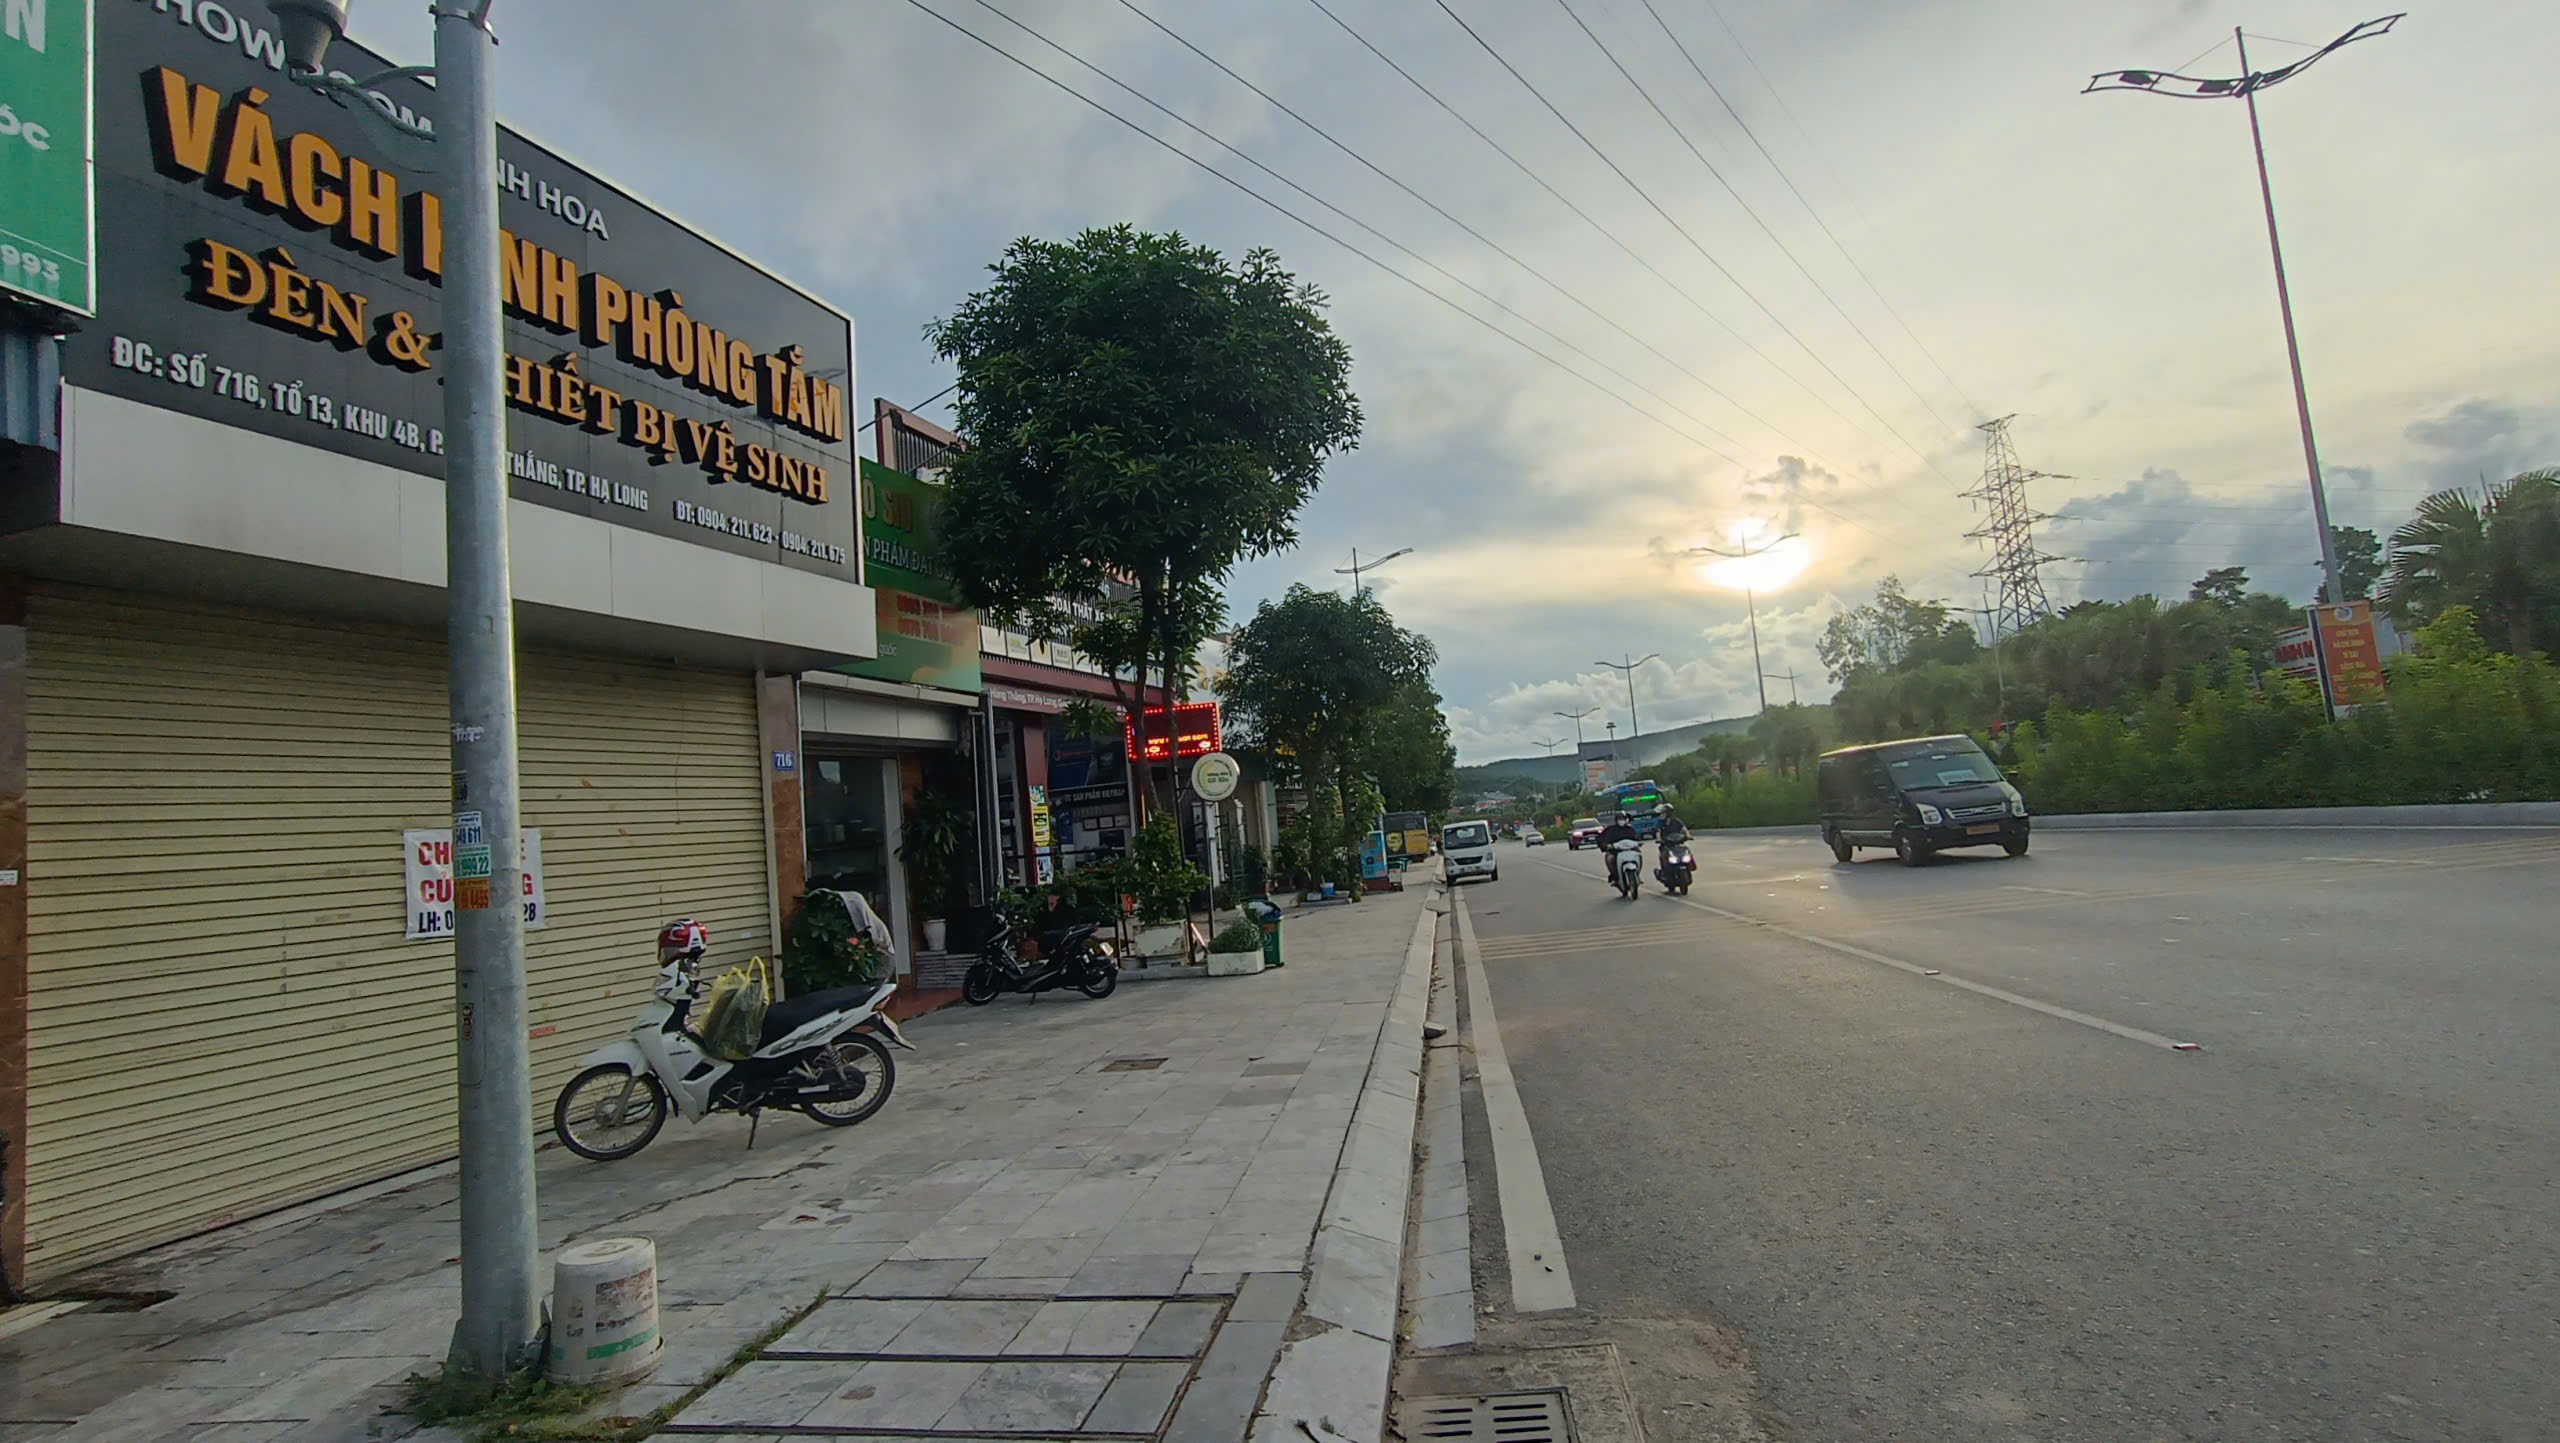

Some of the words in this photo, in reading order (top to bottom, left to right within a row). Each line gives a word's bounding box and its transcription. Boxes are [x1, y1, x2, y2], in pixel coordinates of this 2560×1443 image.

[538, 180, 609, 241] HOA
[160, 64, 398, 259] VÁCH
[595, 273, 755, 406] PHÒNG
[202, 238, 368, 350] ĐÈN
[386, 311, 433, 369] &
[503, 352, 622, 432] HIẾT
[633, 400, 678, 463] BỊ
[687, 418, 740, 483] VỆ
[747, 443, 829, 504] SINH
[112, 336, 164, 377] ĐC:
[168, 352, 208, 388] SỐ
[215, 366, 266, 409] 716,
[273, 380, 304, 415] TỔ
[308, 394, 339, 429] 13,
[346, 404, 388, 440] KHU
[393, 419, 425, 453] 4B,
[566, 468, 586, 494] TP.
[590, 475, 610, 504] HẠ
[614, 482, 649, 511] LONG
[676, 500, 695, 524] ĐT:
[775, 753, 792, 768] 716
[418, 841, 451, 866] CH
[418, 911, 441, 934] LH:
